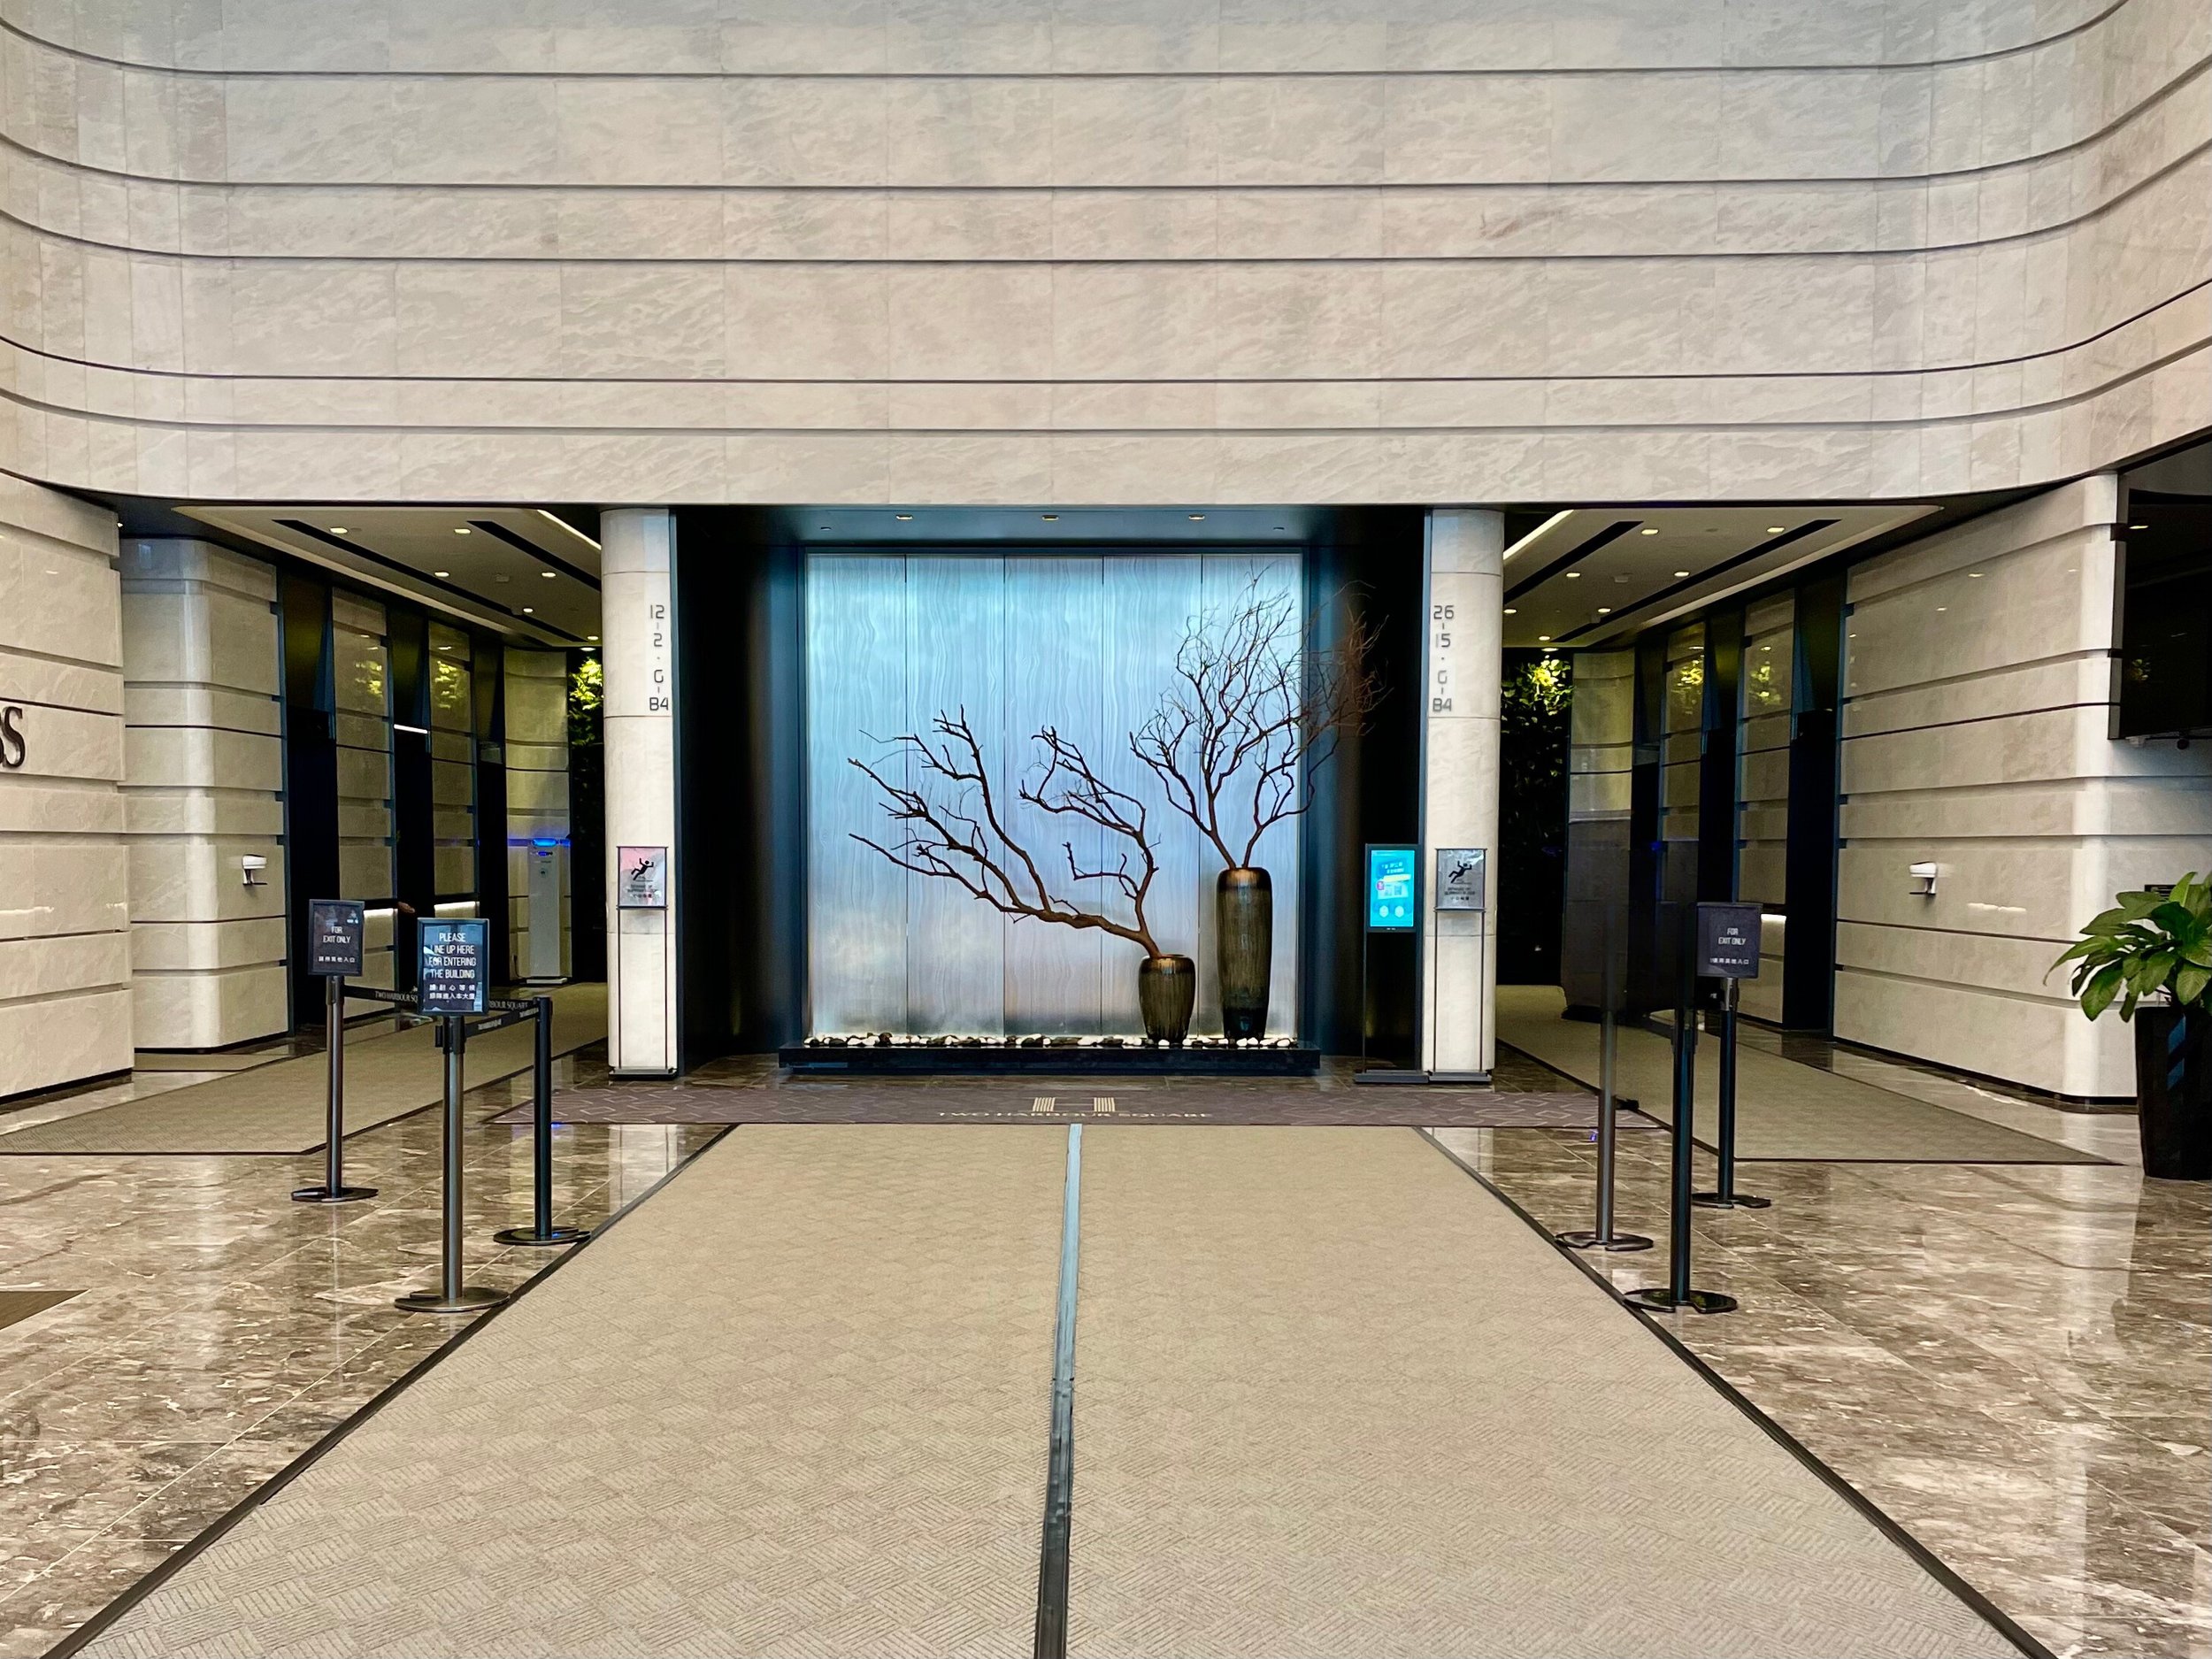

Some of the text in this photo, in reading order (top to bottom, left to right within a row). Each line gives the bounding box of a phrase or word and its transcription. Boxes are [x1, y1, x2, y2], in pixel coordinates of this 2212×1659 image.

[650, 604, 664, 619] 12
[1433, 605, 1454, 619] 26
[653, 633, 663, 647] 2
[1435, 633, 1451, 648] 15
[654, 669, 664, 683] G
[1437, 670, 1448, 684] G
[649, 696, 669, 711] B4
[1432, 697, 1452, 712] B4
[0, 706, 26, 768] S
[331, 926, 343, 934] FOR
[439, 932, 466, 942] PLEASE
[1726, 927, 1739, 936] FOR
[322, 934, 351, 944] EXIT ONLY
[1718, 936, 1747, 946] EXIT ONLY
[446, 944, 456, 955] UP
[457, 944, 475, 955] HERE
[428, 956, 477, 967] FOR ENTERING
[430, 968, 475, 979] THE BUILDING
